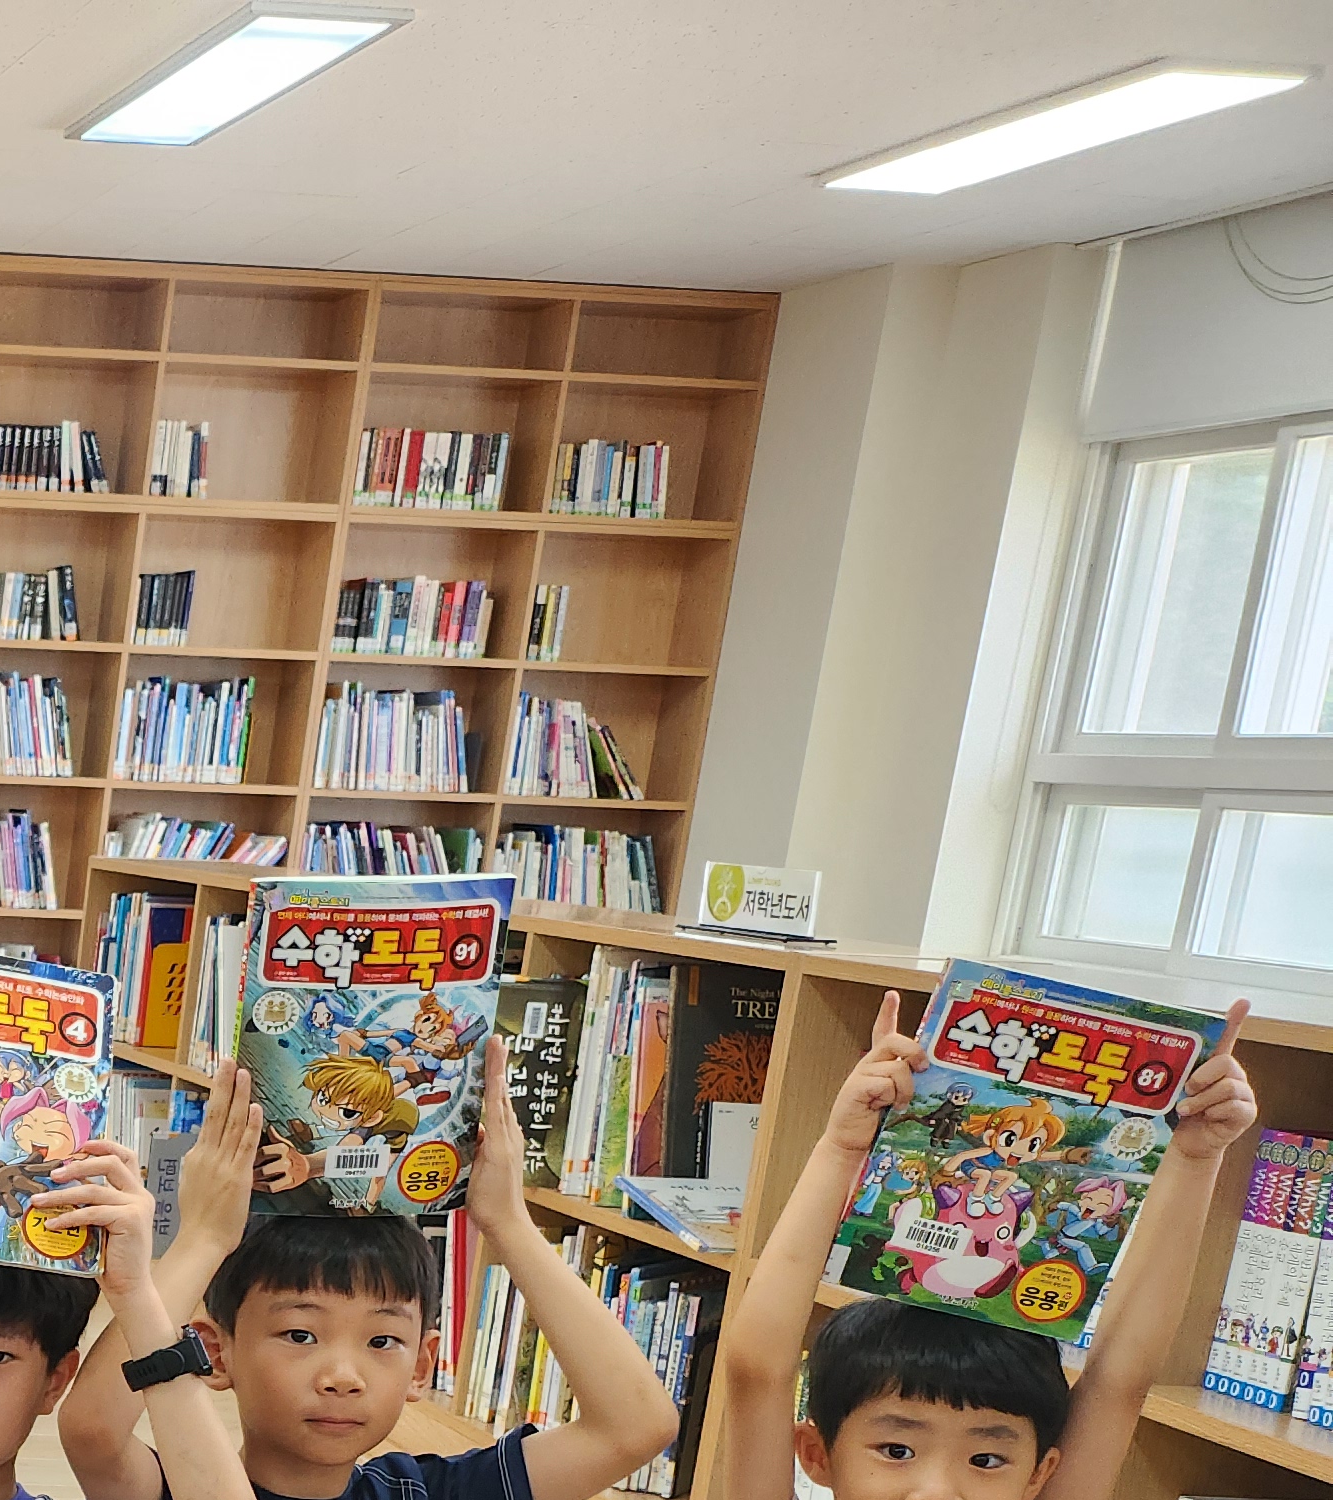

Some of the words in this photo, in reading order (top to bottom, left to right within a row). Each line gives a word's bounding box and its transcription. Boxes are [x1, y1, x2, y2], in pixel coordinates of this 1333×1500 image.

[743, 890, 811, 922] 저학년도서
[455, 942, 477, 960] 91
[65, 1018, 88, 1042] 4
[541, 1002, 571, 1064] 커다란
[1138, 1069, 1165, 1088] 81
[528, 1072, 559, 1131] 공룡들이
[405, 1170, 450, 1192] 응용편
[1020, 1286, 1069, 1311] 응용편
